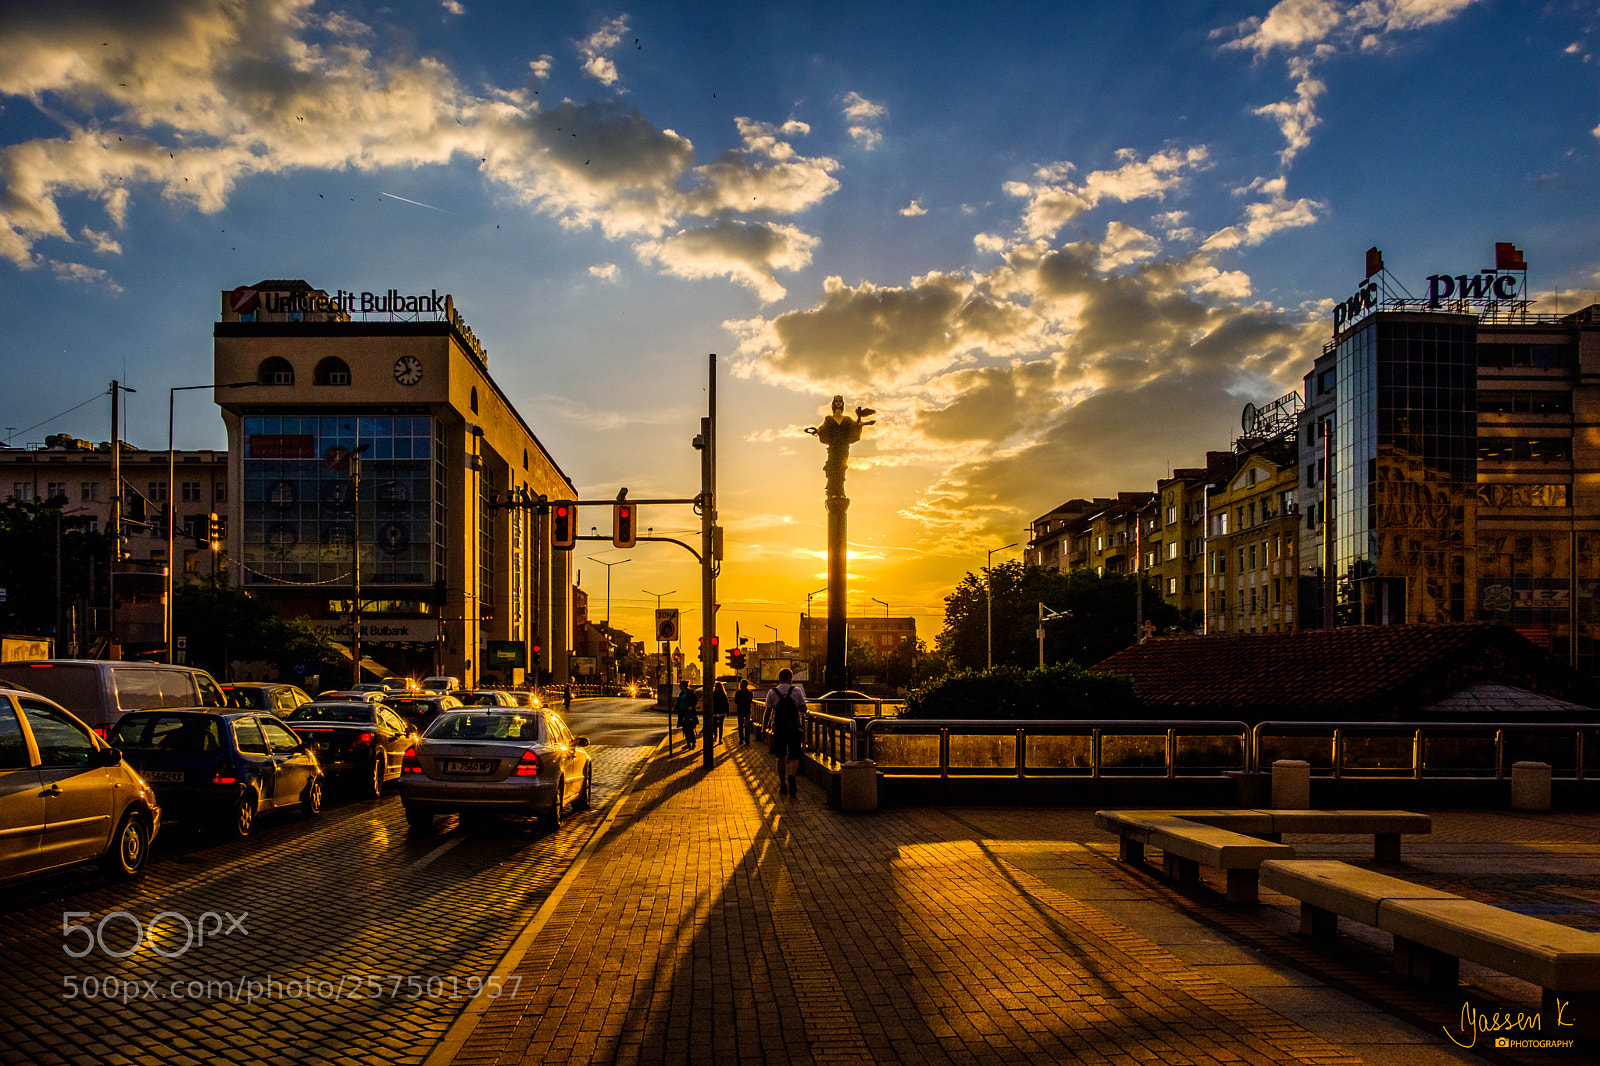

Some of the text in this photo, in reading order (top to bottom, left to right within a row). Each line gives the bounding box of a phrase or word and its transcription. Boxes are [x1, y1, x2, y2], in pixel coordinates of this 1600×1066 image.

[266, 290, 445, 313] UniCredit Bulbank
[1426, 274, 1517, 309] pwc
[1333, 283, 1377, 338] pwc
[370, 625, 409, 636] Bulbank
